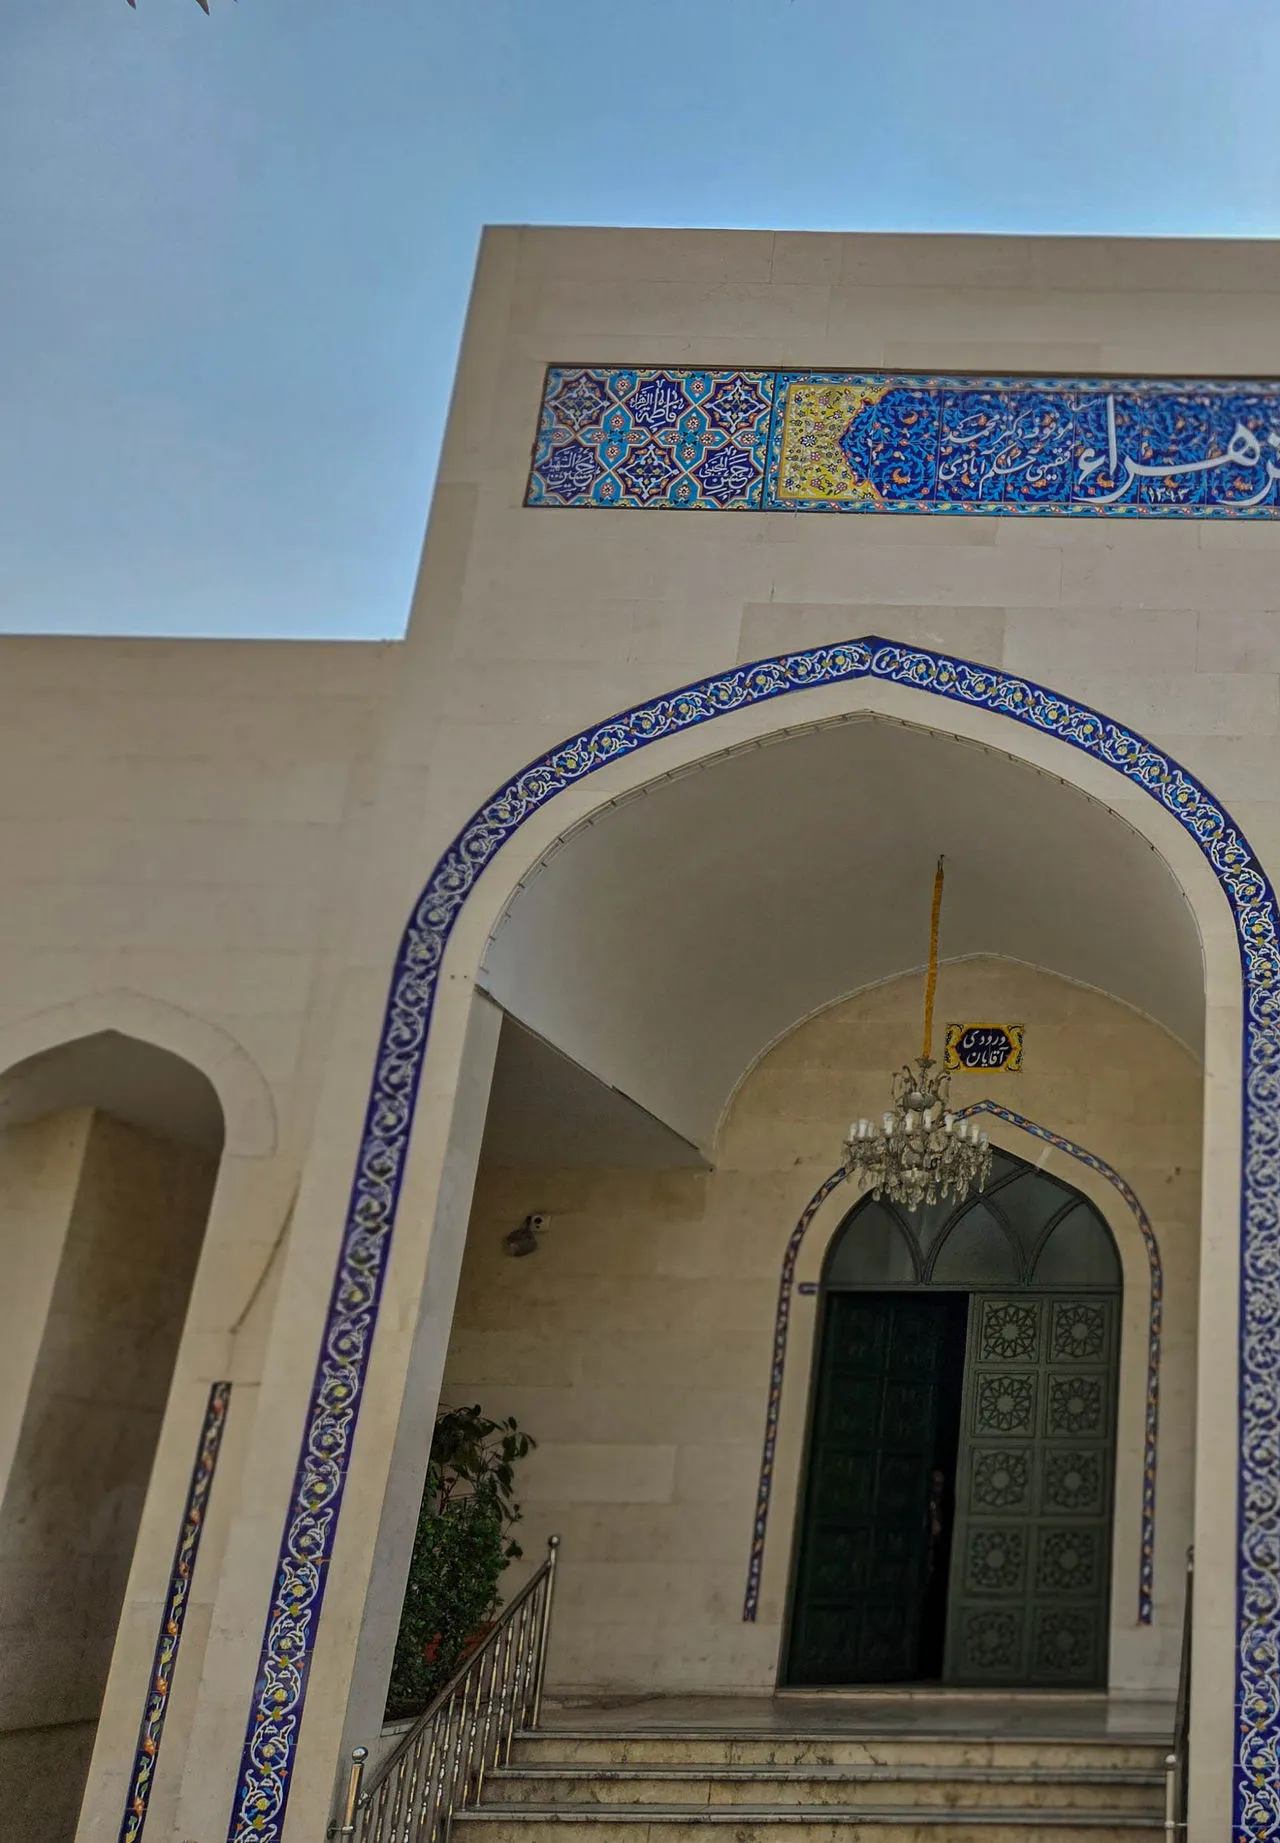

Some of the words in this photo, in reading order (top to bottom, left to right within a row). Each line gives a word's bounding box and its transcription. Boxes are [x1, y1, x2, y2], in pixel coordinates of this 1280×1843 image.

[941, 412, 1000, 444] محمد
[963, 1030, 1007, 1049] ورودی
[966, 1046, 1009, 1067] آقایان
